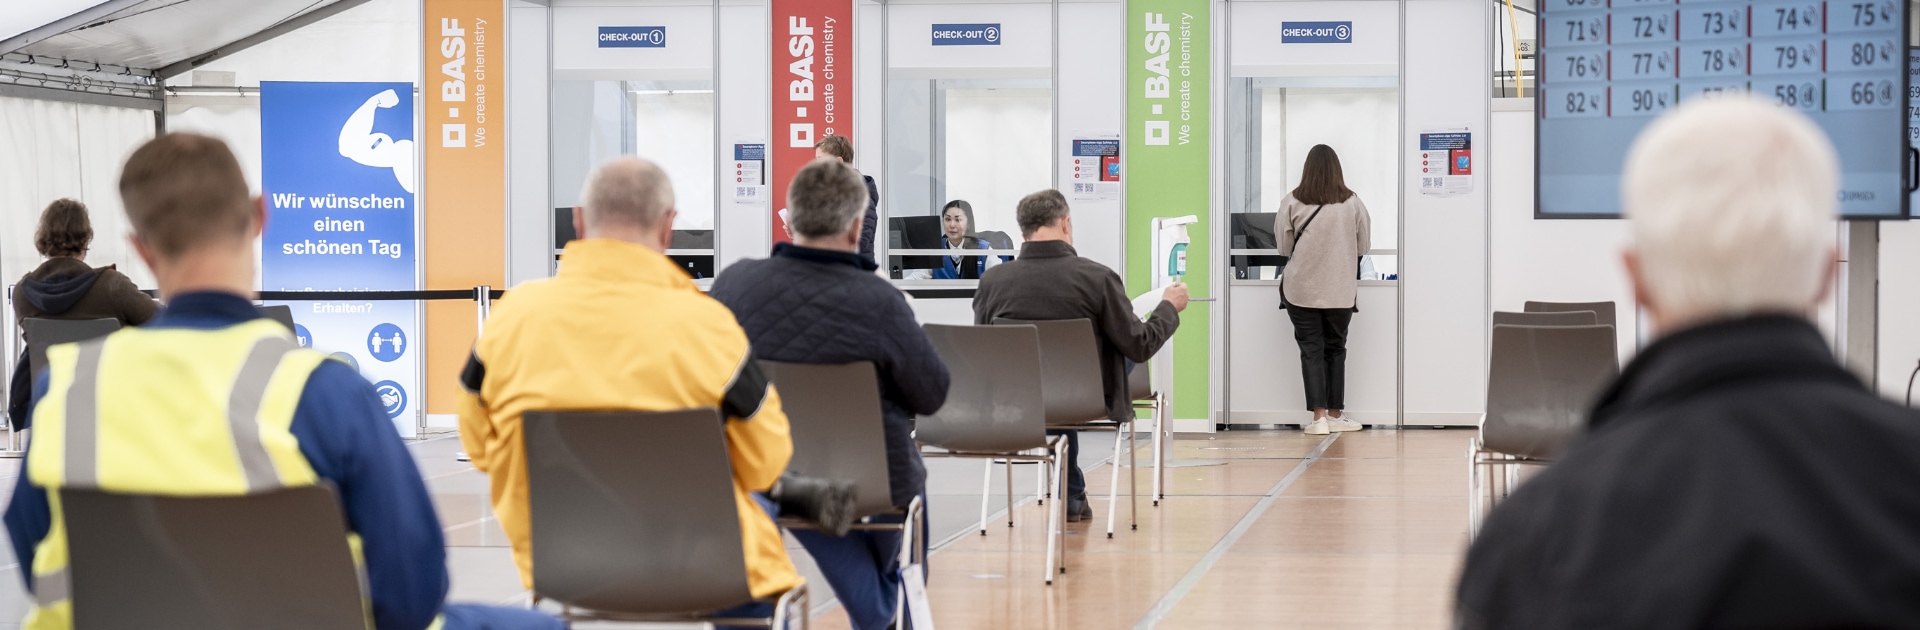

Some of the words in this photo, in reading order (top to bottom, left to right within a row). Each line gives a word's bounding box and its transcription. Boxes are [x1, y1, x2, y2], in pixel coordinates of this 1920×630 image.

[599, 33, 648, 42] CHECK-OUT
[933, 30, 983, 39] CHECK-OUT
[1282, 28, 1334, 37] CHECK-OUT
[1566, 21, 1585, 41] 71
[1633, 16, 1653, 37] 72
[1702, 12, 1724, 34] 73
[1775, 8, 1798, 30] 74
[1852, 3, 1875, 26] 75
[441, 18, 466, 102] BASF
[473, 17, 488, 81] chemistry
[789, 16, 815, 102] BASF
[822, 16, 837, 79] chemistry
[1145, 12, 1171, 98] BASF
[1178, 12, 1194, 76] chemistry
[1566, 57, 1586, 77] 76
[1633, 53, 1653, 74] 77
[1702, 50, 1724, 71] 78
[1775, 46, 1797, 68] 79
[1851, 42, 1875, 65] 80
[474, 84, 486, 123] create
[823, 83, 835, 123] create
[1179, 80, 1191, 120] create
[1566, 92, 1586, 113] 82
[1632, 90, 1653, 111] 90
[1775, 85, 1797, 106] 58
[1851, 81, 1875, 104] 66
[473, 128, 486, 148] We
[1179, 125, 1191, 145] We
[272, 194, 306, 208] Wir
[310, 193, 405, 209] wünschen
[313, 216, 365, 232] einen
[282, 239, 363, 255] schönen
[367, 239, 402, 259] Tag
[312, 302, 373, 313] Erhalten?
